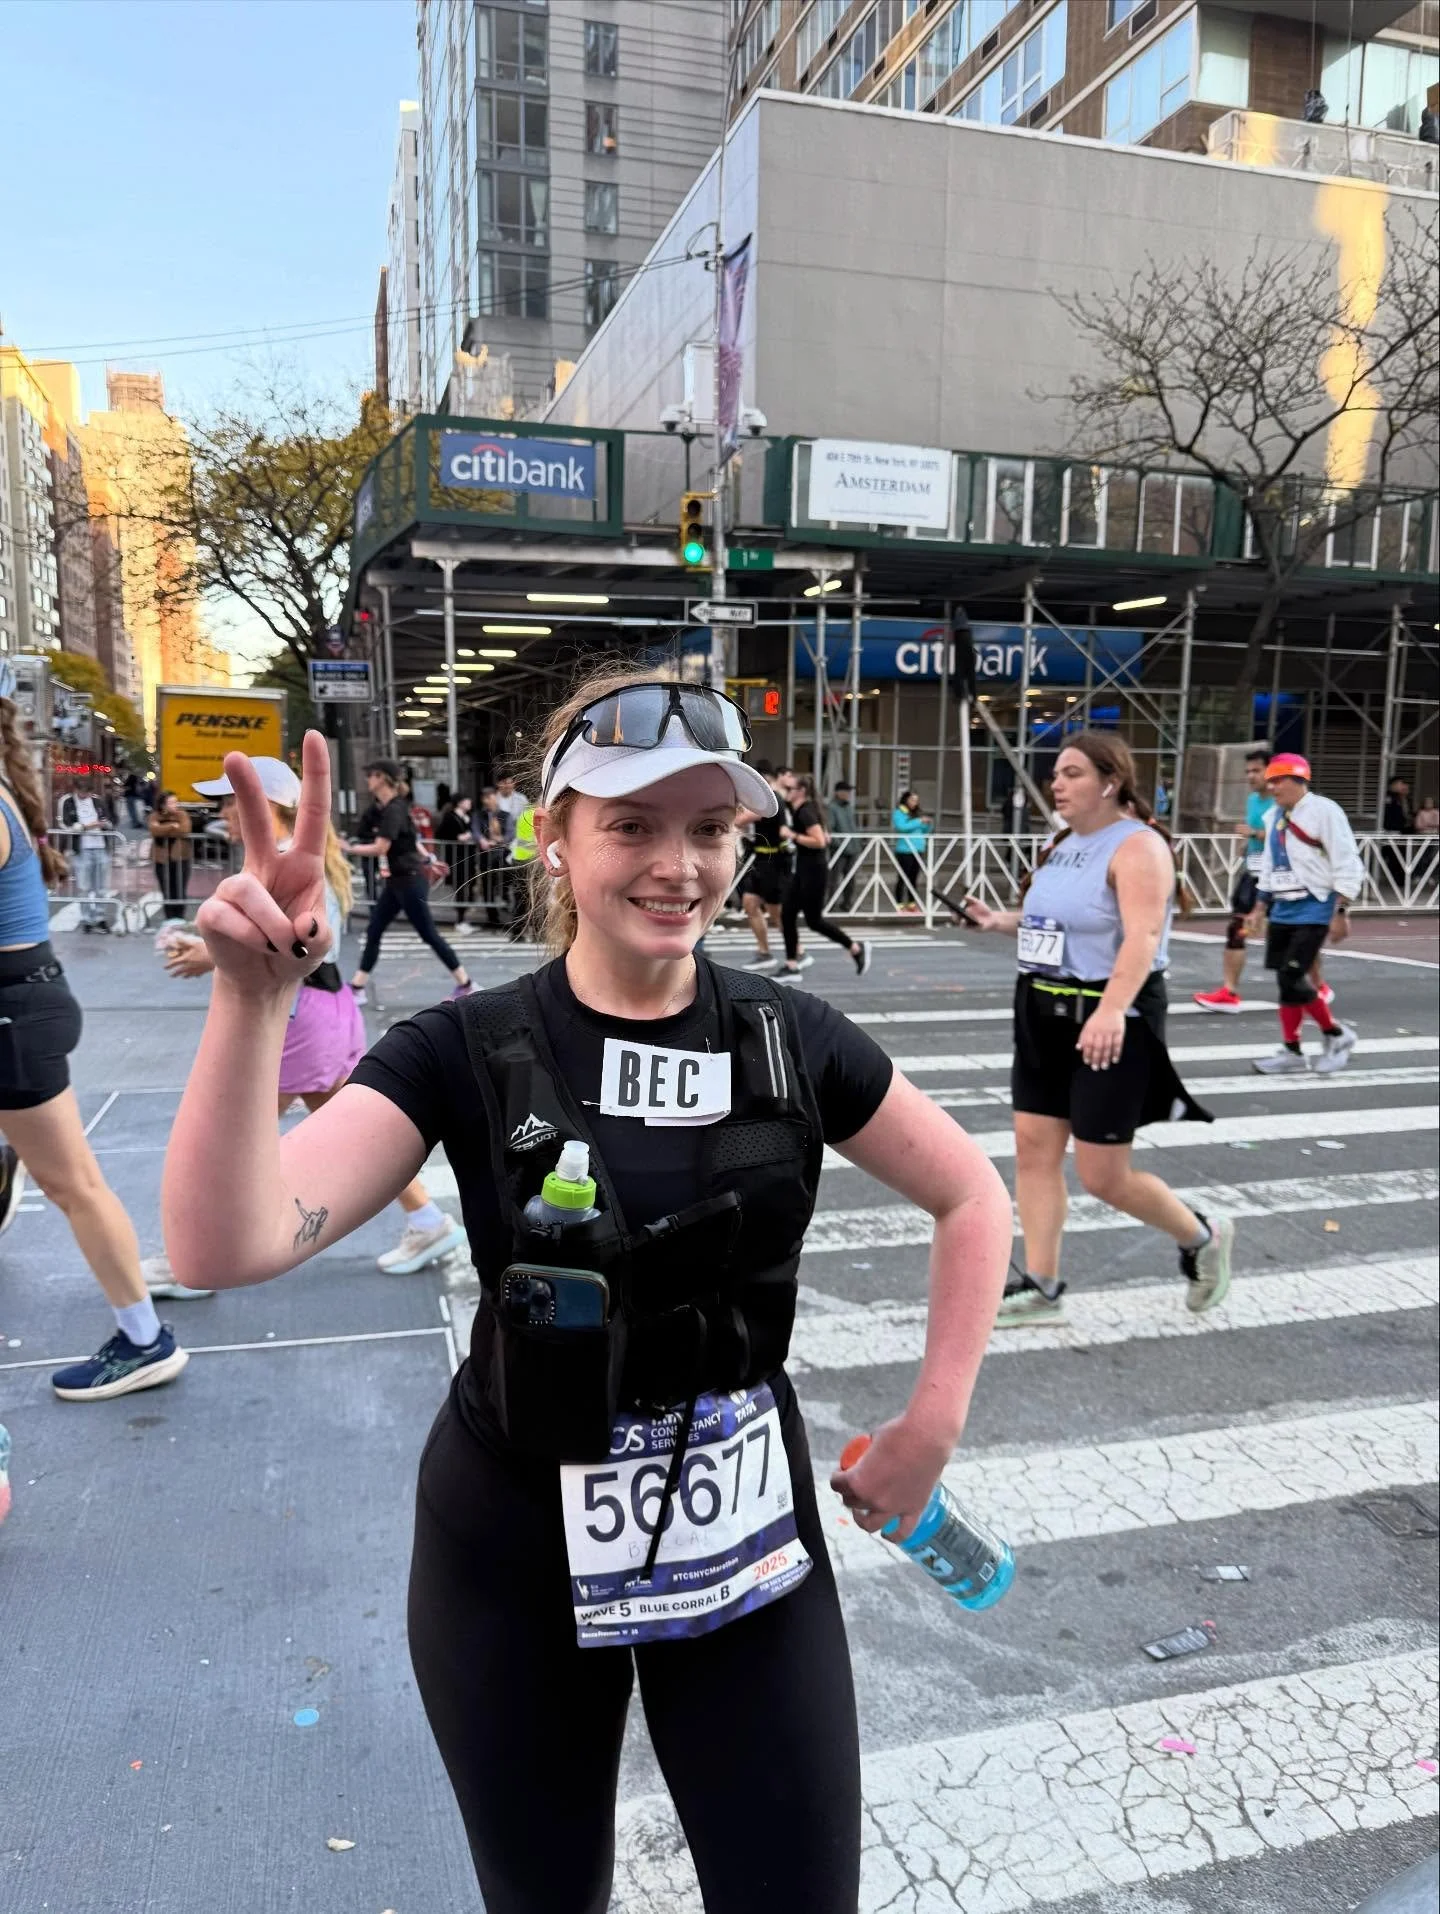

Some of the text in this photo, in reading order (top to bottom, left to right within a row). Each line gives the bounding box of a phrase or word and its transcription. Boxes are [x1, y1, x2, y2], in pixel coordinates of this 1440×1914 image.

[450, 444, 585, 491] citibank
[729, 607, 750, 619] WAY
[895, 628, 1049, 677] citiank
[175, 712, 270, 731] PENSKE
[618, 1050, 700, 1109] BEC
[735, 1400, 758, 1423] TATA
[651, 1432, 700, 1450] SERVES
[584, 1421, 771, 1543] 56677
[753, 1552, 788, 1581] 2025
[580, 1585, 731, 1620] WAVE 5 BLUE CORRAL B
